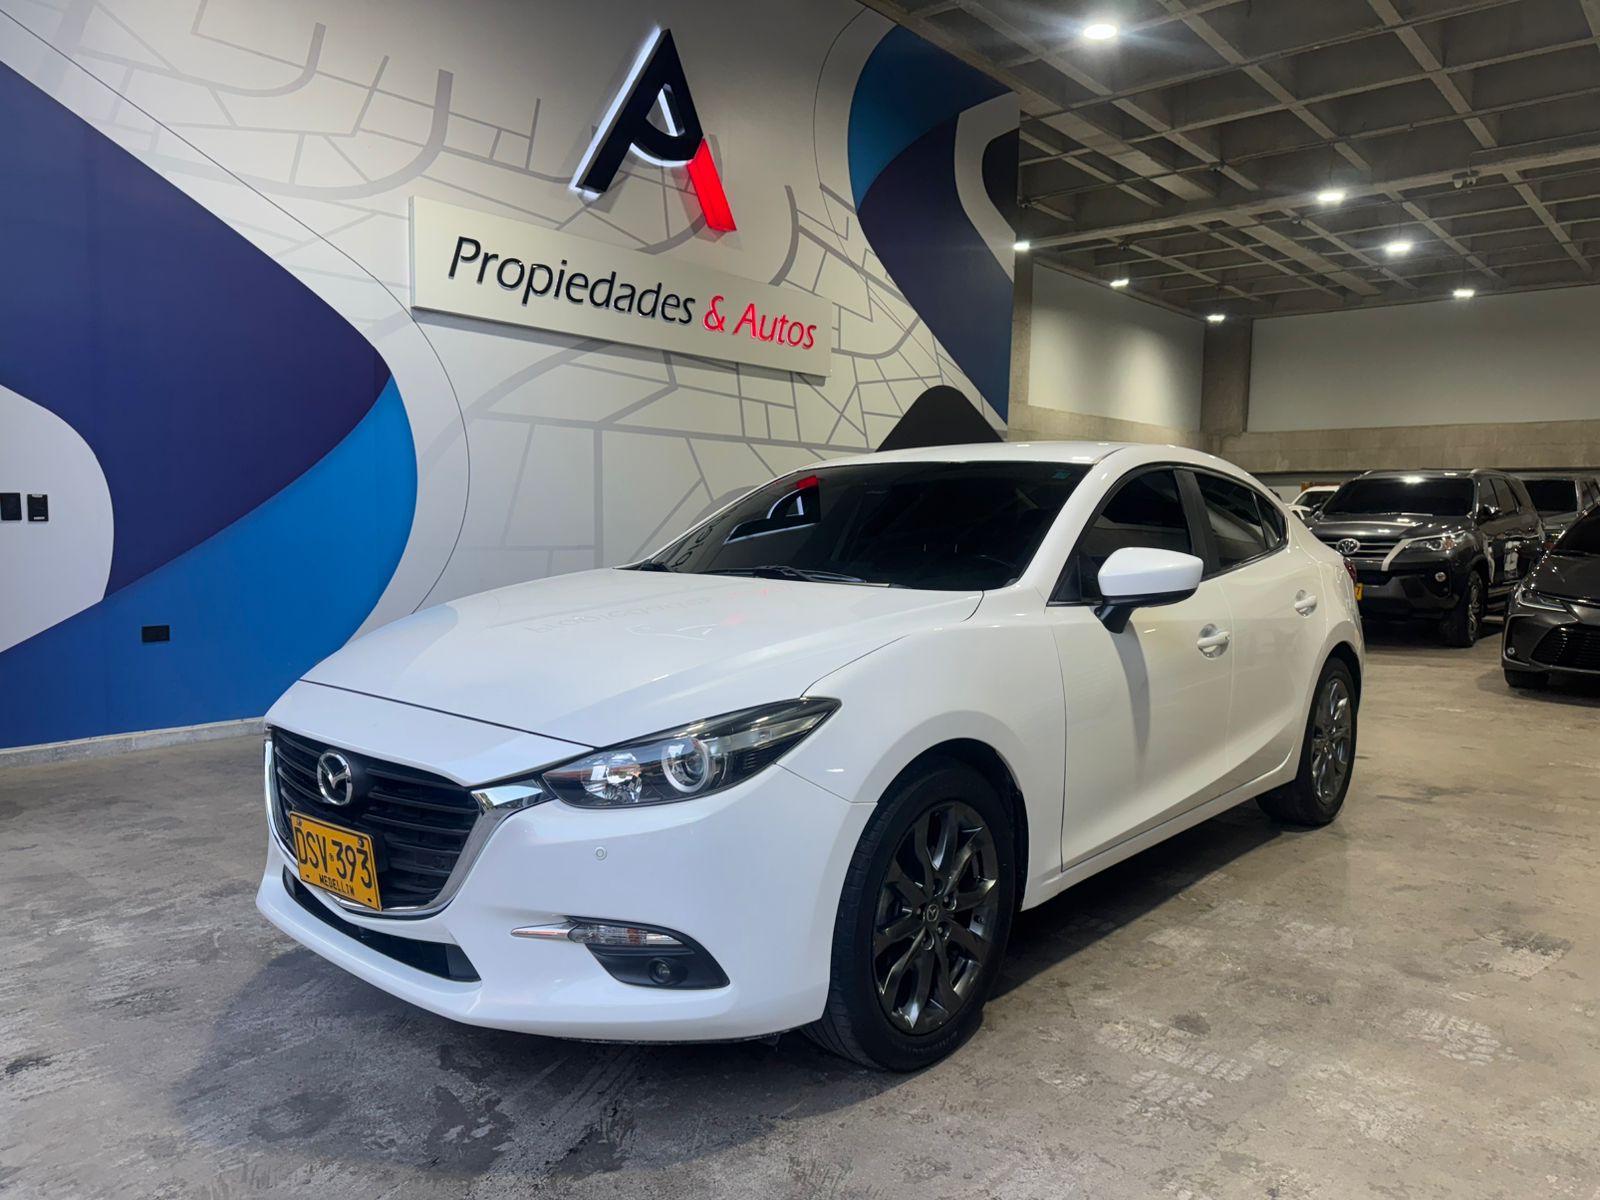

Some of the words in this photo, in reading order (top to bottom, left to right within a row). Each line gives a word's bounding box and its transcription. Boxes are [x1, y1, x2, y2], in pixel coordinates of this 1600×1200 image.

[447, 236, 696, 325] Propiedades
[703, 295, 727, 332] &
[732, 303, 817, 350] Autos
